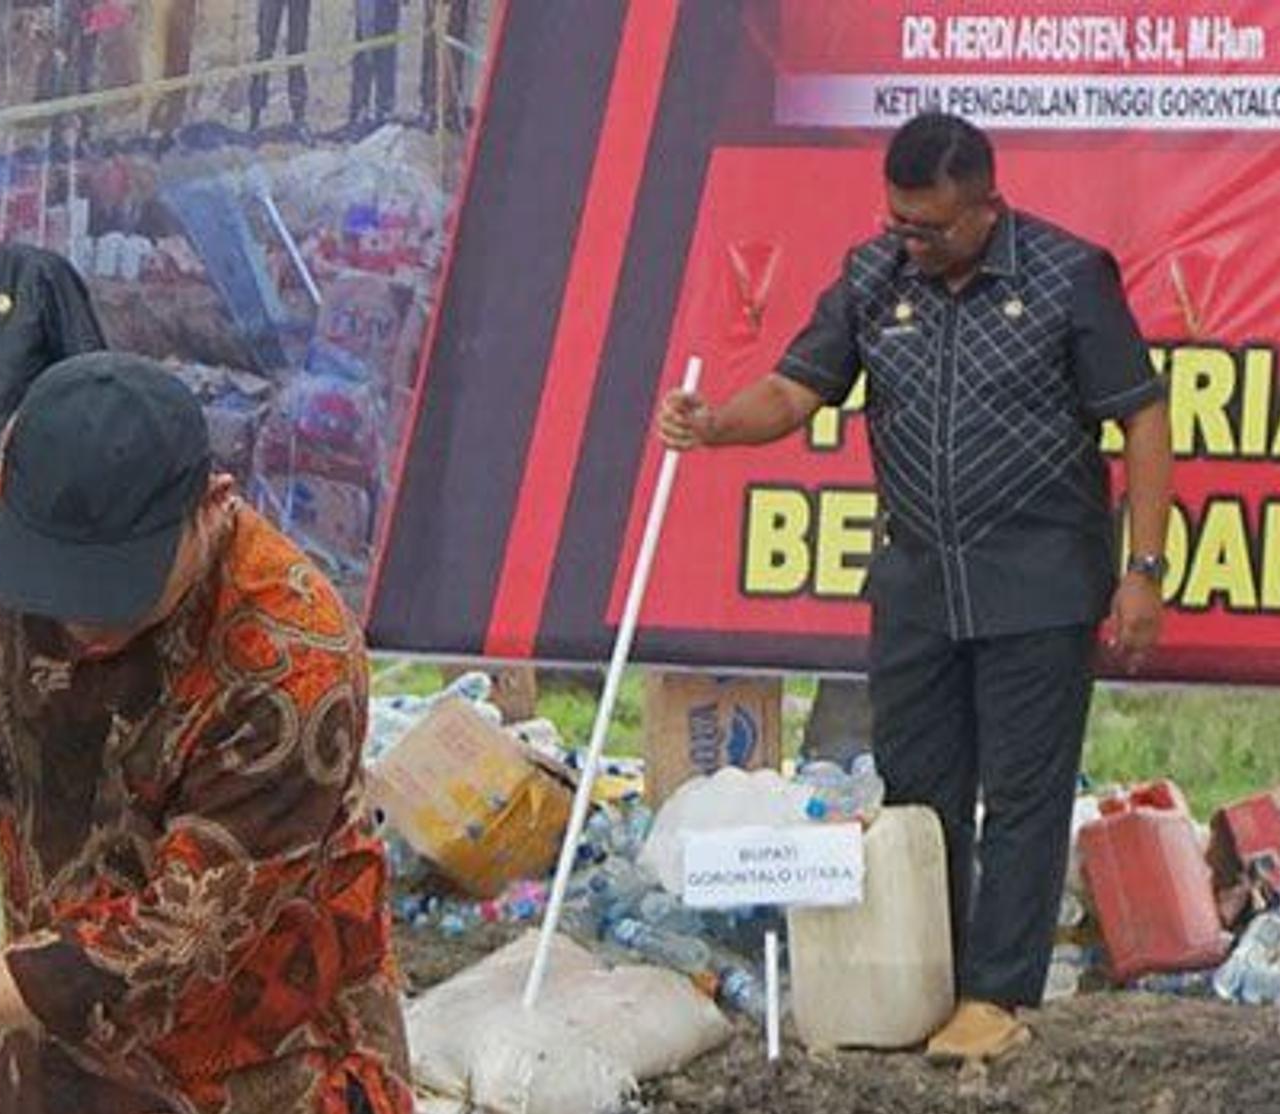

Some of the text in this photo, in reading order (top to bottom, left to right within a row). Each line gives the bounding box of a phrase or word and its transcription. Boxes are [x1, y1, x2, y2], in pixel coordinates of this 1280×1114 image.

[902, 16, 937, 60] DR.
[874, 86, 942, 116] KETUA
[948, 87, 1078, 117] PENGADILAN
[1084, 88, 1154, 117] TINGGI
